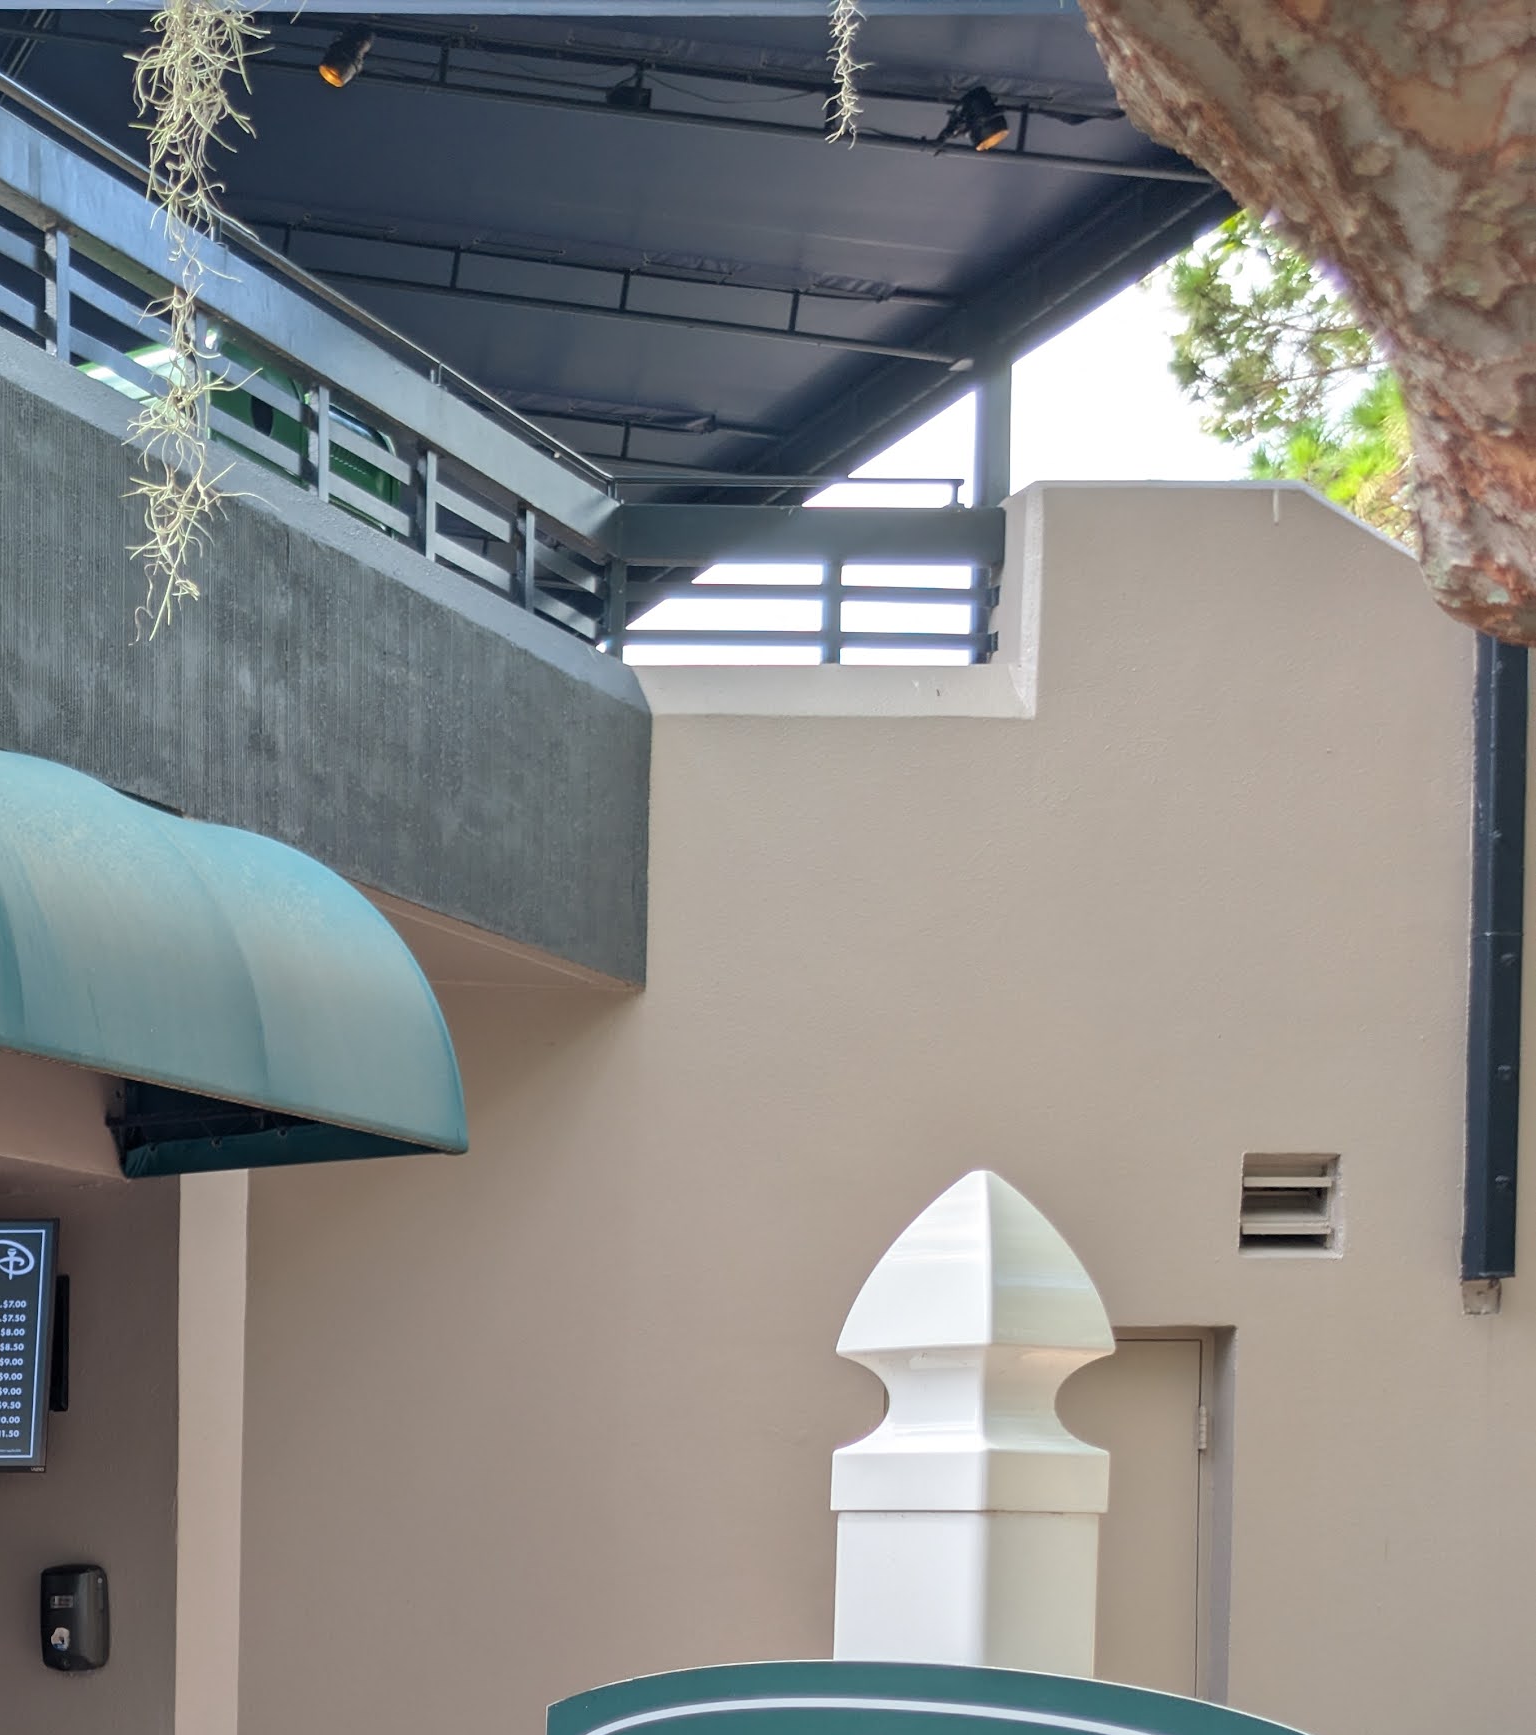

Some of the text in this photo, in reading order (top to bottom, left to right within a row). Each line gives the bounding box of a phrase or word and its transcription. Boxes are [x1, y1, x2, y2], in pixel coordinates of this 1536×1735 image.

[3, 1300, 26, 1309] $7.00
[3, 1314, 26, 1323] $7.50
[0, 1328, 25, 1337] $8.00
[0, 1343, 24, 1352] $8.50
[0, 1357, 23, 1367] $9.00
